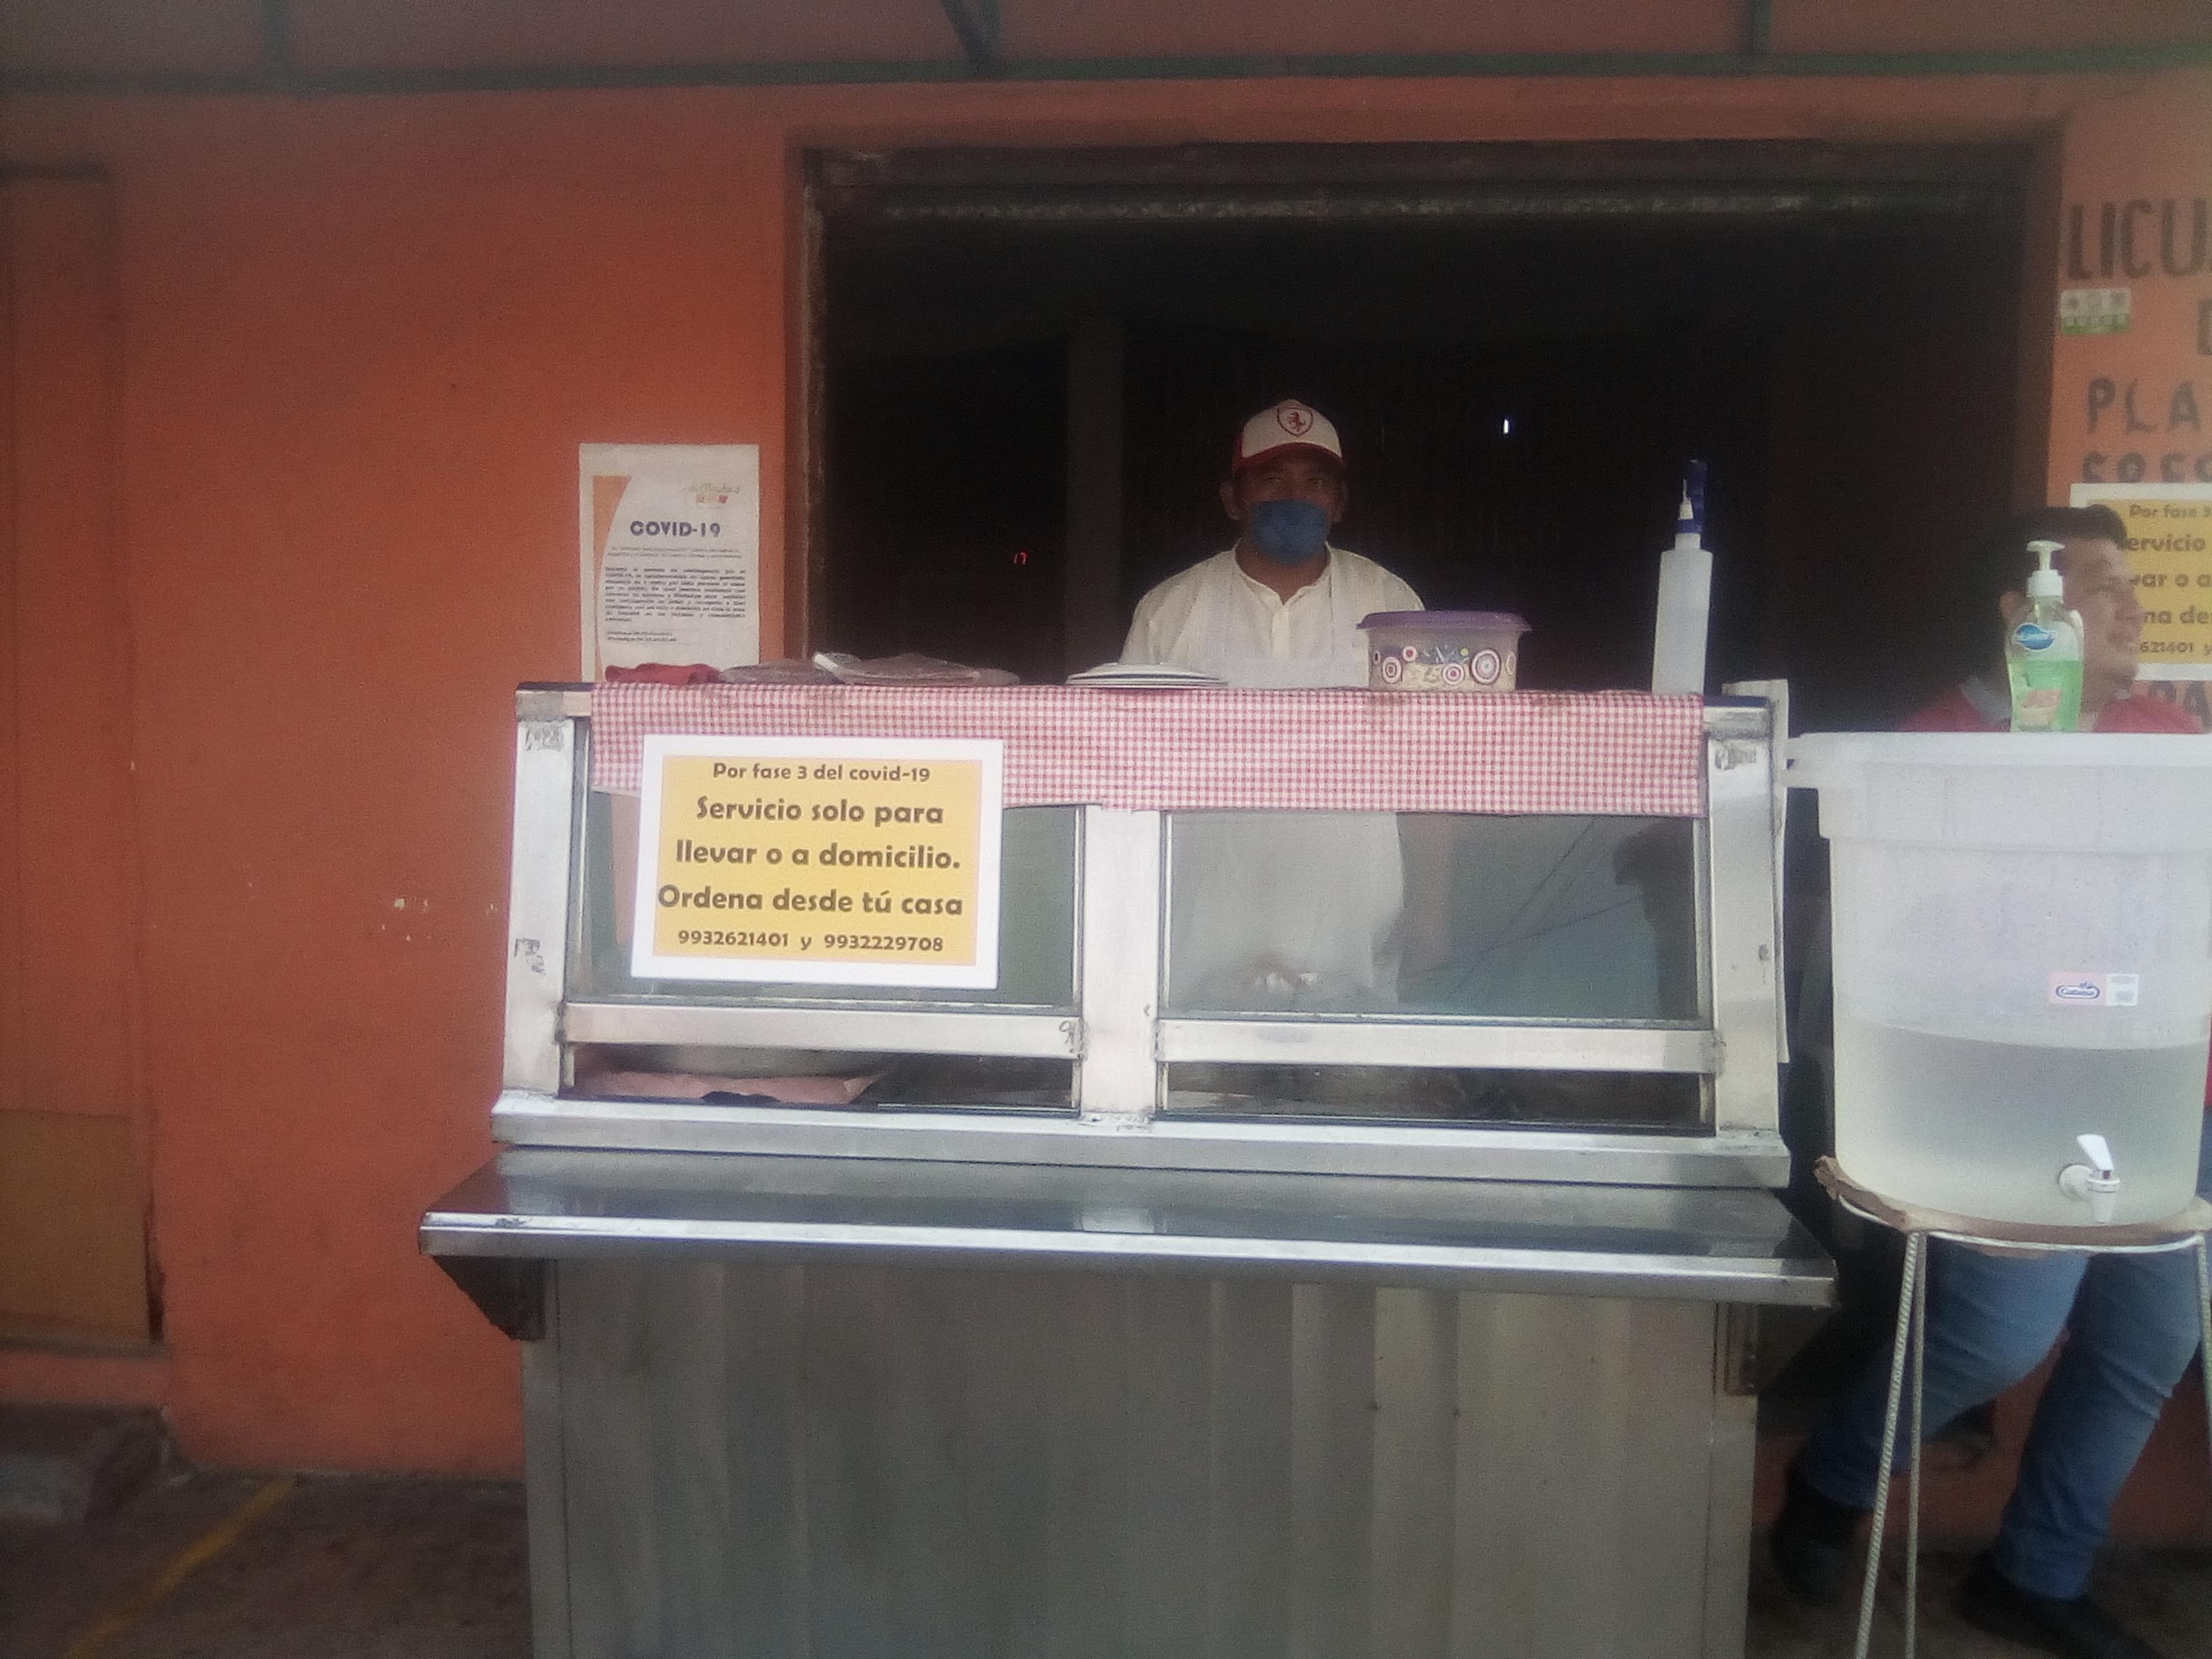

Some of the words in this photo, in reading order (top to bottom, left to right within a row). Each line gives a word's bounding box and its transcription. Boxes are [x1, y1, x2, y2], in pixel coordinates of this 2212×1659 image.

[2067, 199, 2212, 279] LICU
[2129, 504, 2158, 518] Por
[2163, 504, 2197, 518] fase
[630, 520, 720, 537] COVID-19
[2126, 534, 2206, 552] ervicio
[2139, 641, 2193, 653] 621401
[714, 762, 746, 778] Por
[753, 763, 791, 779] fase
[798, 766, 807, 779] 3
[813, 764, 842, 779] del
[849, 766, 930, 781] covid-19
[697, 796, 801, 820] Servicio
[812, 799, 864, 821] solo
[875, 806, 943, 827] para
[677, 840, 757, 863] llevar
[766, 848, 782, 864] o
[792, 849, 808, 865] a
[819, 842, 960, 868] domicilio.
[658, 884, 762, 909] Ordena
[773, 888, 853, 912] desde
[863, 890, 891, 913] tú
[901, 898, 962, 915] casa
[678, 930, 787, 946] 9932621401
[800, 937, 812, 951] y
[824, 935, 943, 951] 9932229708
